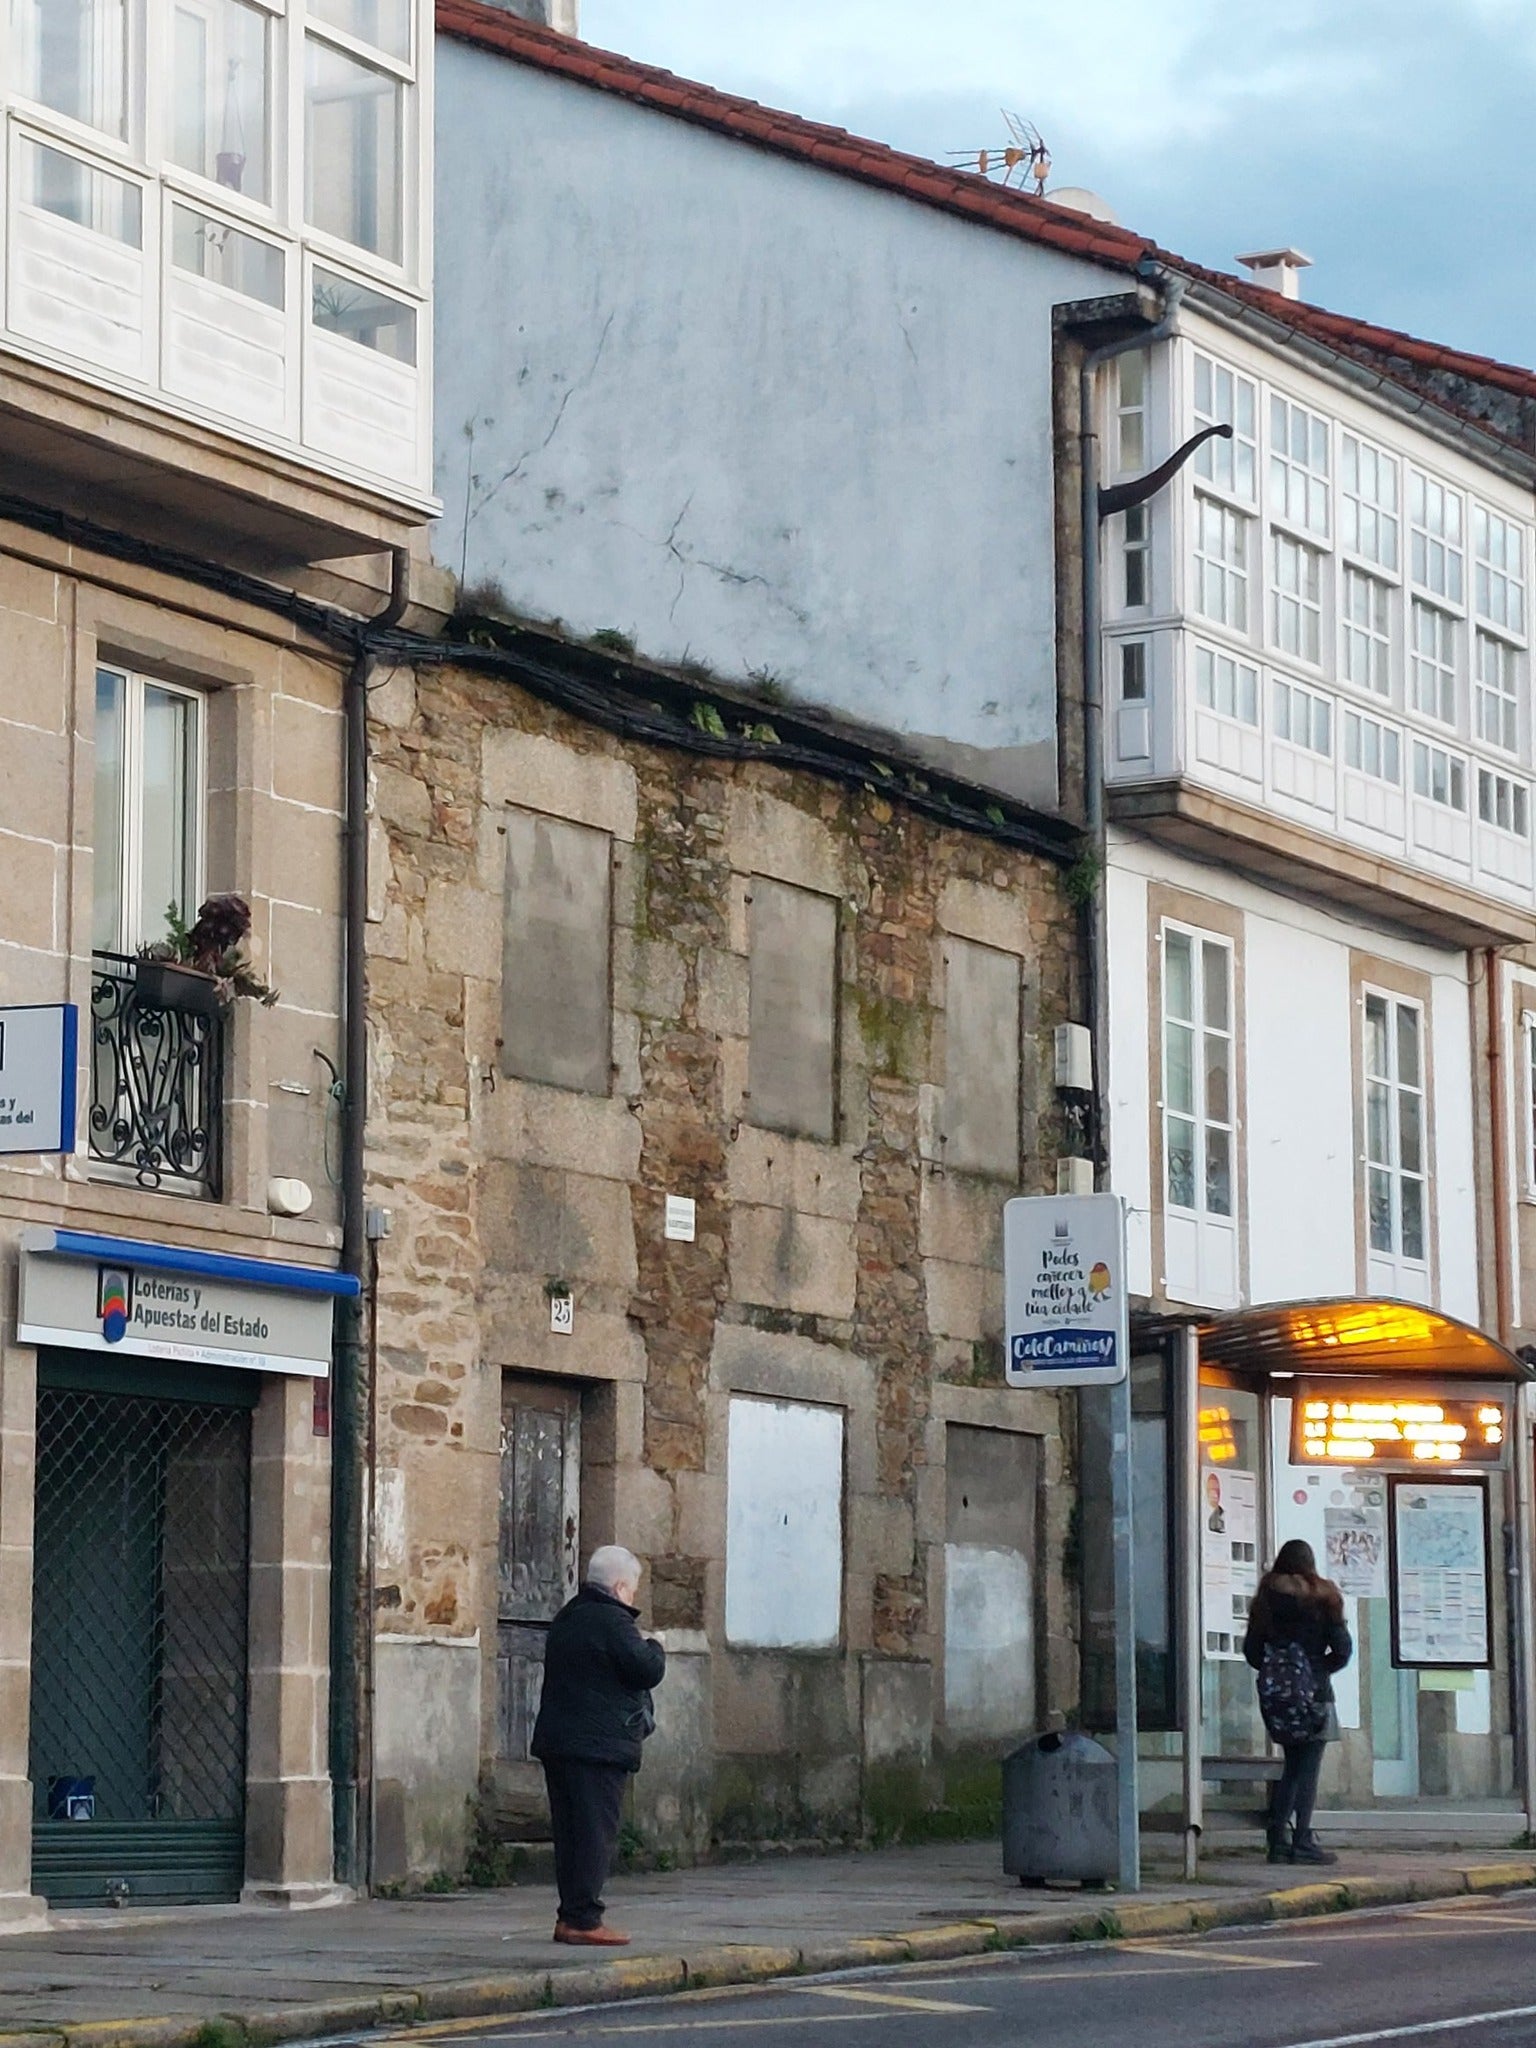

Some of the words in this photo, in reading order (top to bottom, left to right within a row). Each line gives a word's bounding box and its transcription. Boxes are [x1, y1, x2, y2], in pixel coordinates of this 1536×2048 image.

[9, 1098, 17, 1112] y
[16, 1109, 34, 1124] del
[1042, 1248, 1079, 1269] Podes
[134, 1276, 190, 1303] Loterías
[194, 1288, 202, 1310] y
[134, 1303, 197, 1330] Apuestas
[200, 1310, 221, 1334] del
[223, 1315, 269, 1339] Estado
[554, 1300, 571, 1324] 25
